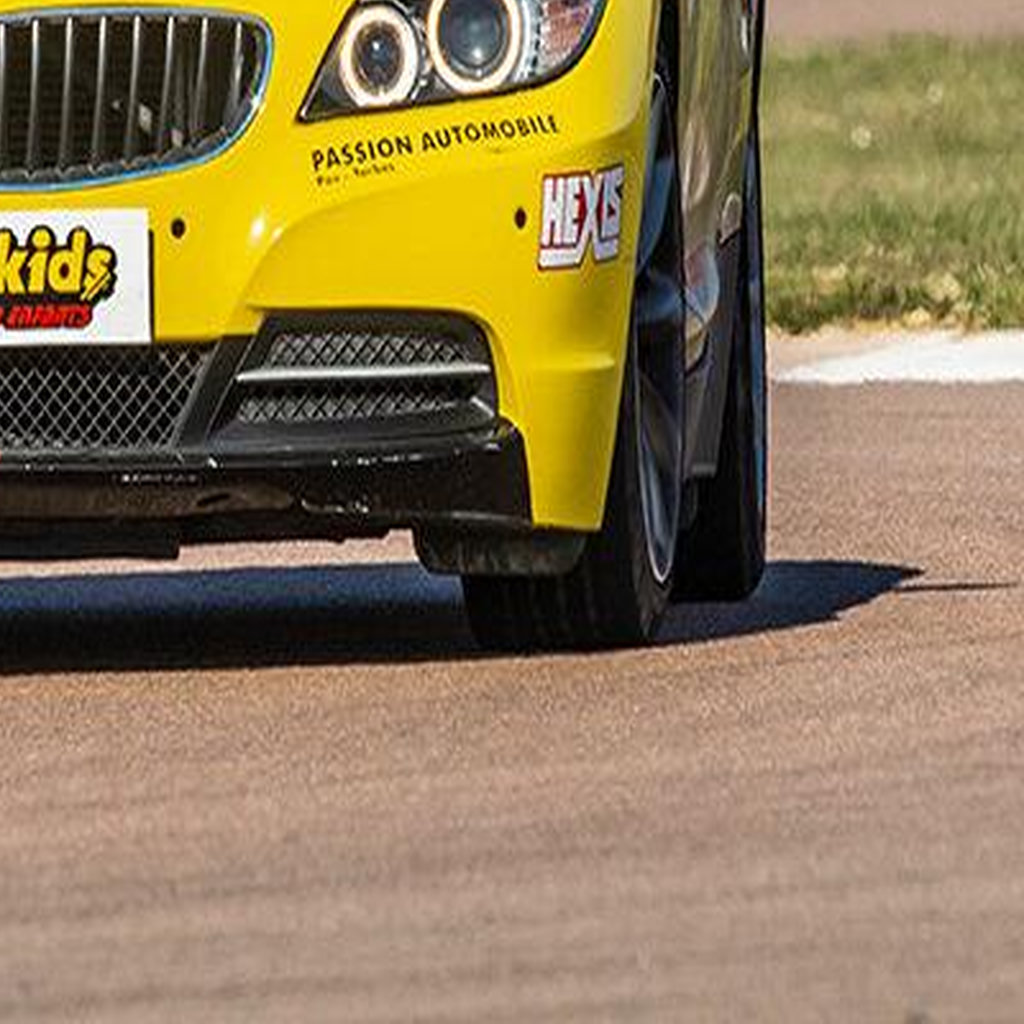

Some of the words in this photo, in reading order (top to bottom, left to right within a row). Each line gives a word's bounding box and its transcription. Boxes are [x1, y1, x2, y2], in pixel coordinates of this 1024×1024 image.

[311, 135, 414, 173] PASSION
[421, 113, 560, 152] AUTOMOBILE
[537, 161, 626, 271] HEXIS
